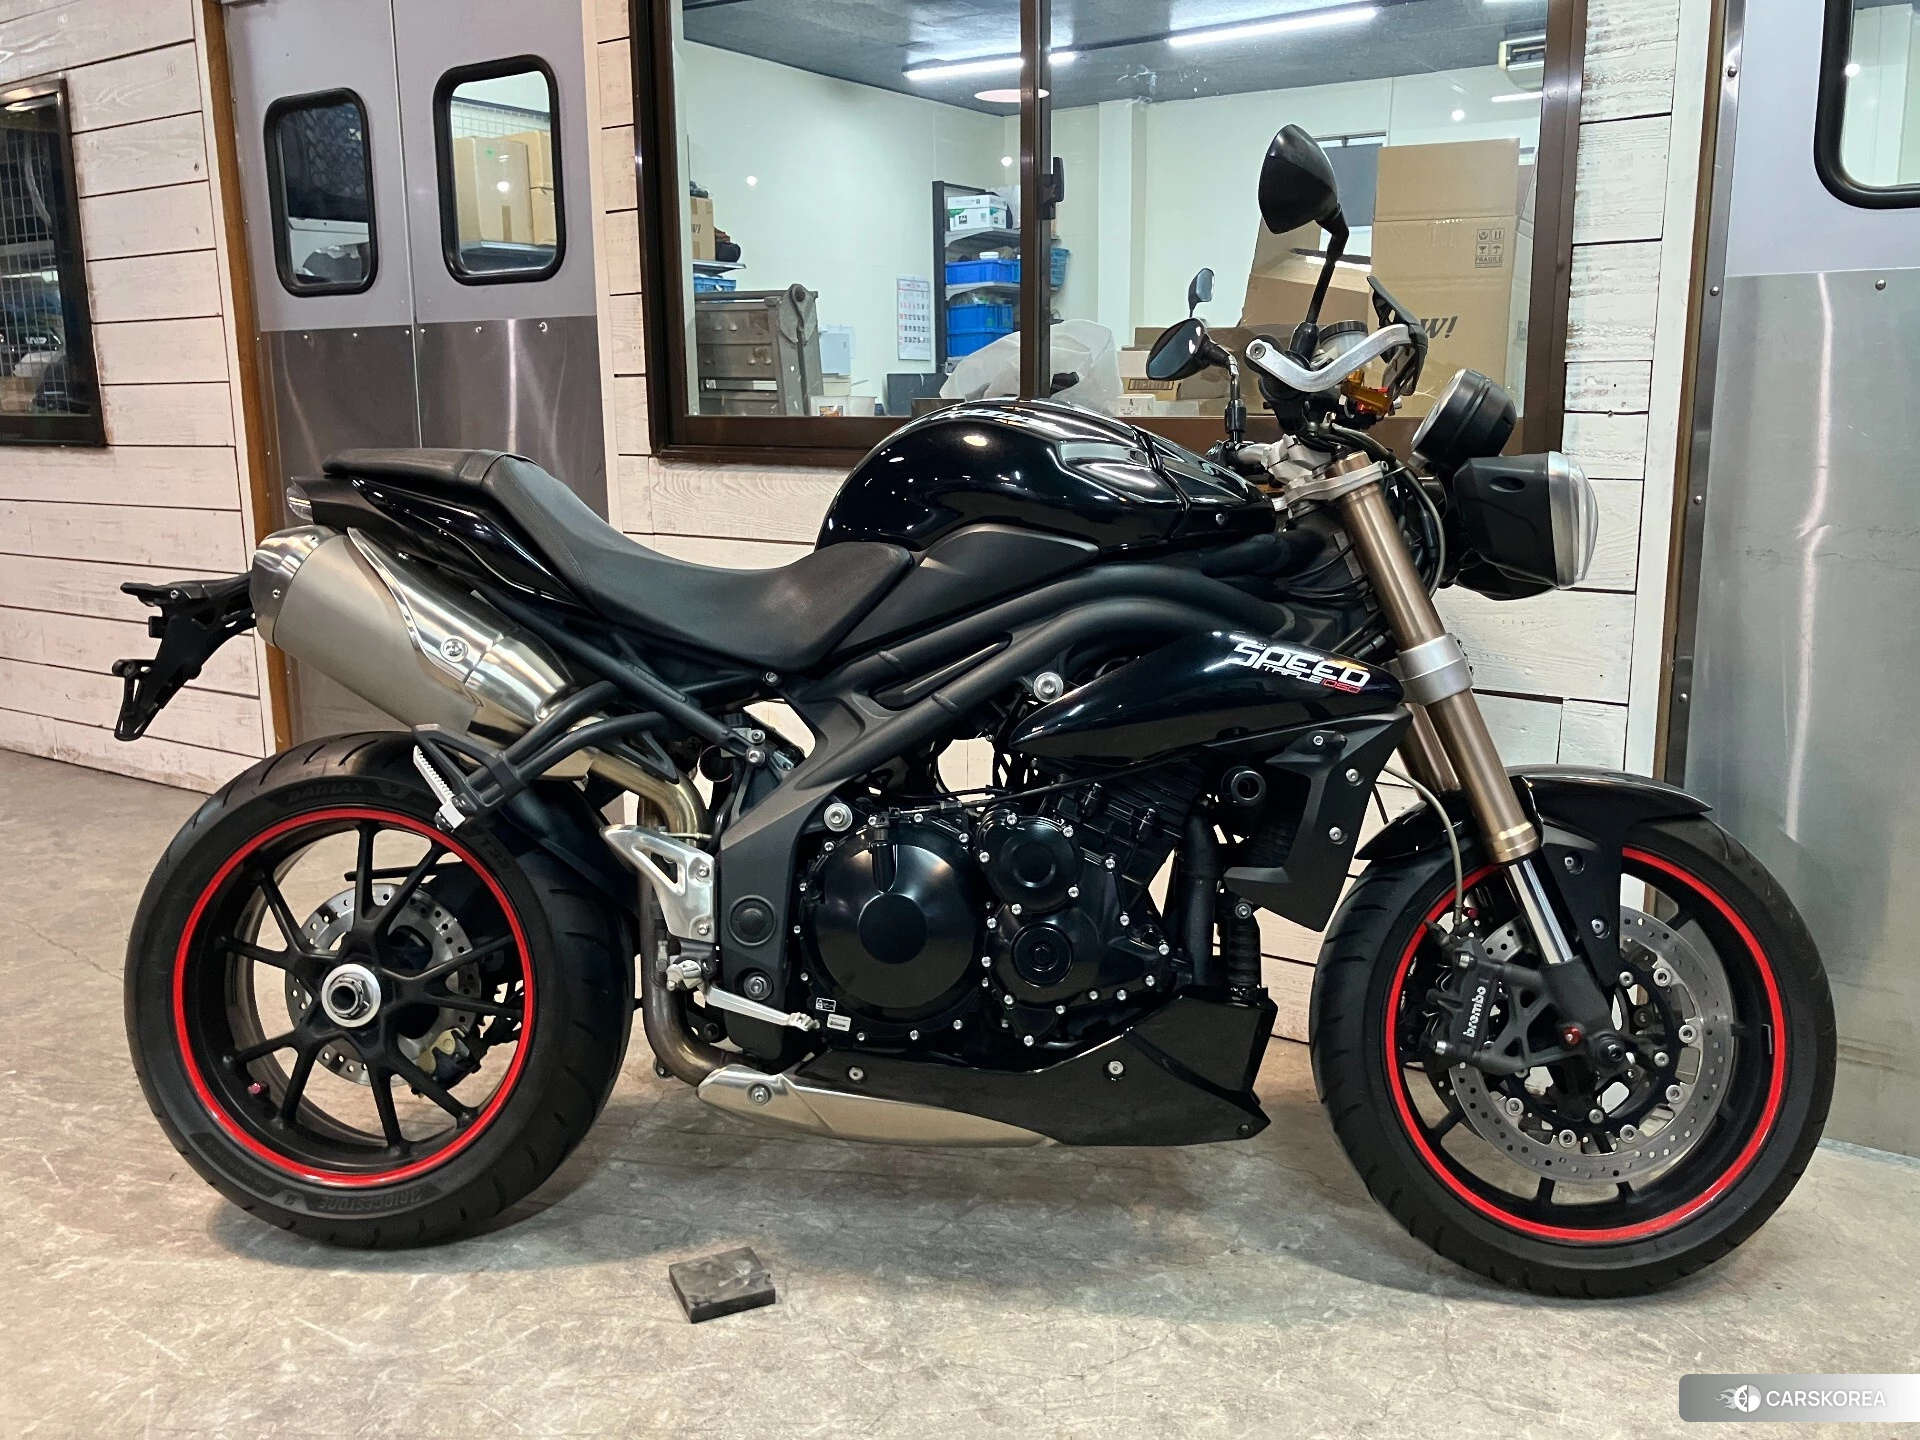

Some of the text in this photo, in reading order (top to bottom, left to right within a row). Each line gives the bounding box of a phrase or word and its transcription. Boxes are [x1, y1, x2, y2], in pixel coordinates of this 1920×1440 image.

[1475, 255, 1503, 263] FRAGILE
[1228, 642, 1371, 687] SPEED
[1263, 663, 1323, 684] TRIPLE
[1463, 986, 1486, 1037] brembo
